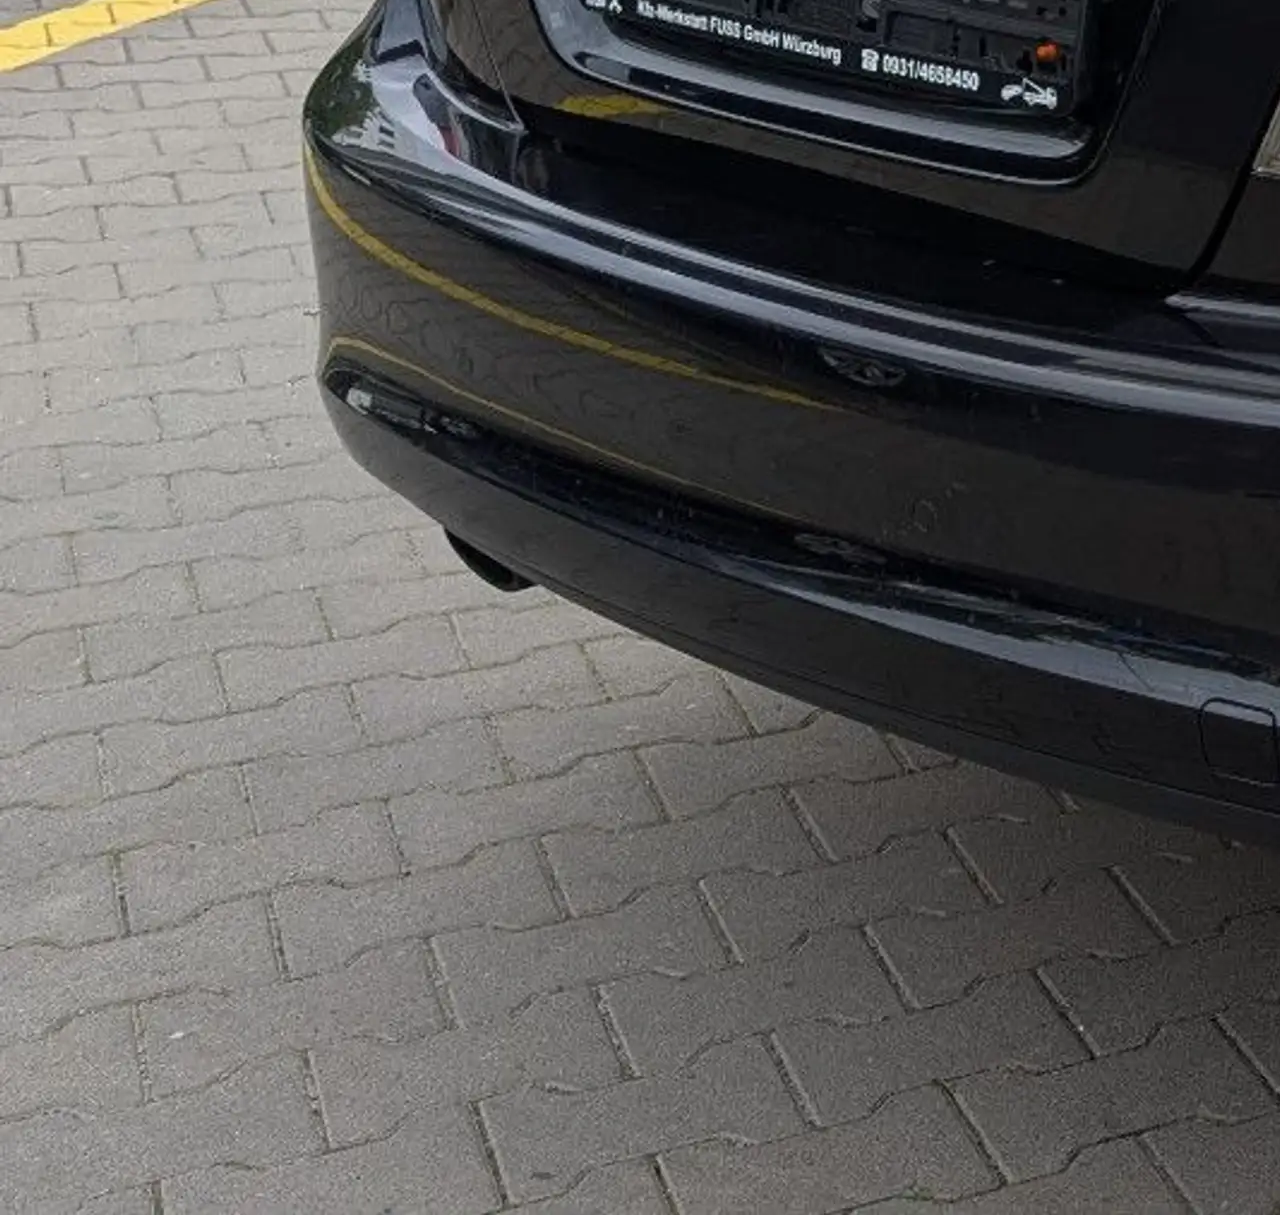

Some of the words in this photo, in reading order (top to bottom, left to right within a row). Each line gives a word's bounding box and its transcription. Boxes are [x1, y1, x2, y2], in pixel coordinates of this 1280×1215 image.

[710, 15, 741, 39] FUSS
[744, 24, 780, 49] GmbH
[782, 32, 842, 66] Würzburg
